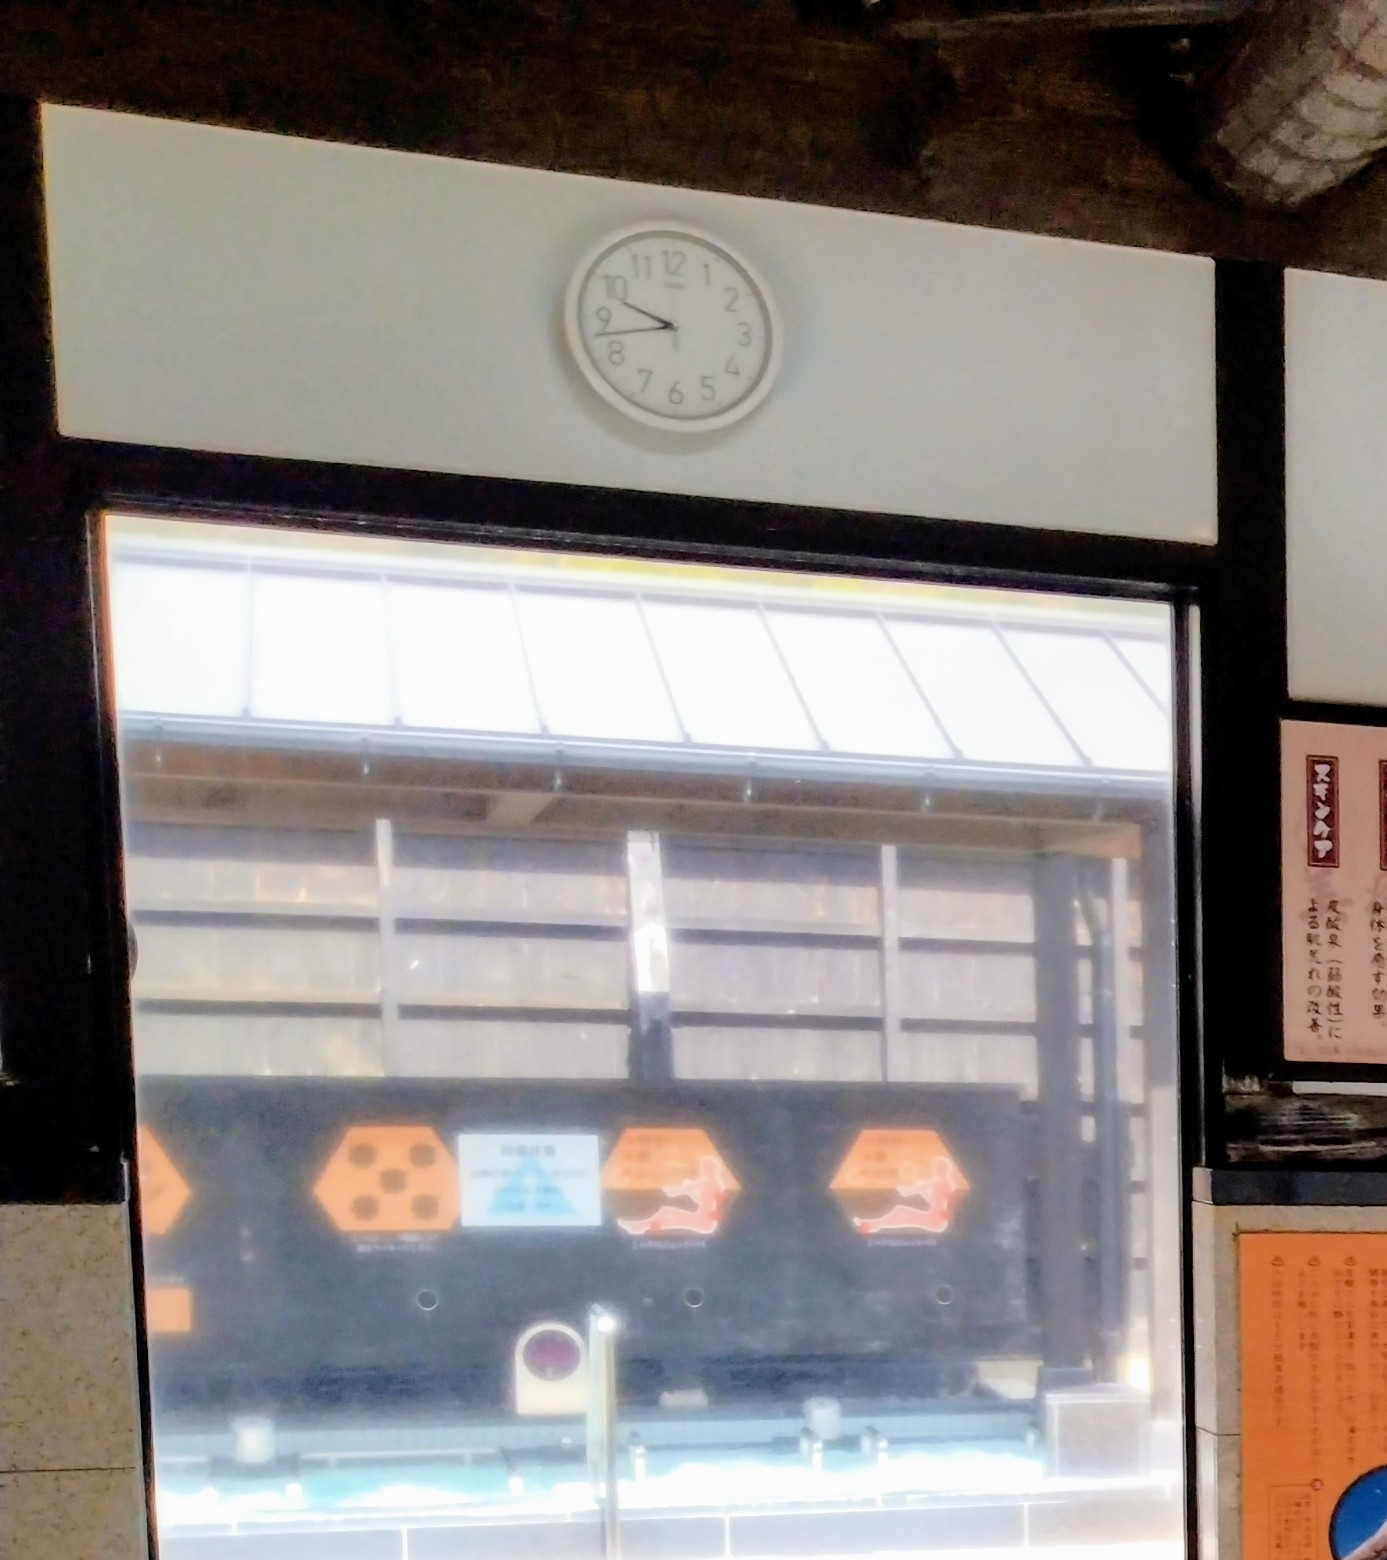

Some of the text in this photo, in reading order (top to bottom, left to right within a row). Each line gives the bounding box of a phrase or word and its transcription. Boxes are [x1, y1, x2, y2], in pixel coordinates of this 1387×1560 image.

[631, 253, 651, 280] 11
[661, 250, 687, 276] 12
[702, 263, 711, 288] 1
[603, 274, 628, 300] 10
[724, 287, 739, 312] 2
[595, 306, 612, 332] 9
[736, 321, 752, 347] 3
[607, 340, 625, 366] 8
[724, 352, 740, 376] 4
[636, 368, 653, 394] 7
[668, 380, 684, 405] 6
[700, 375, 716, 401] 5
[1312, 763, 1334, 859] スキンケア
